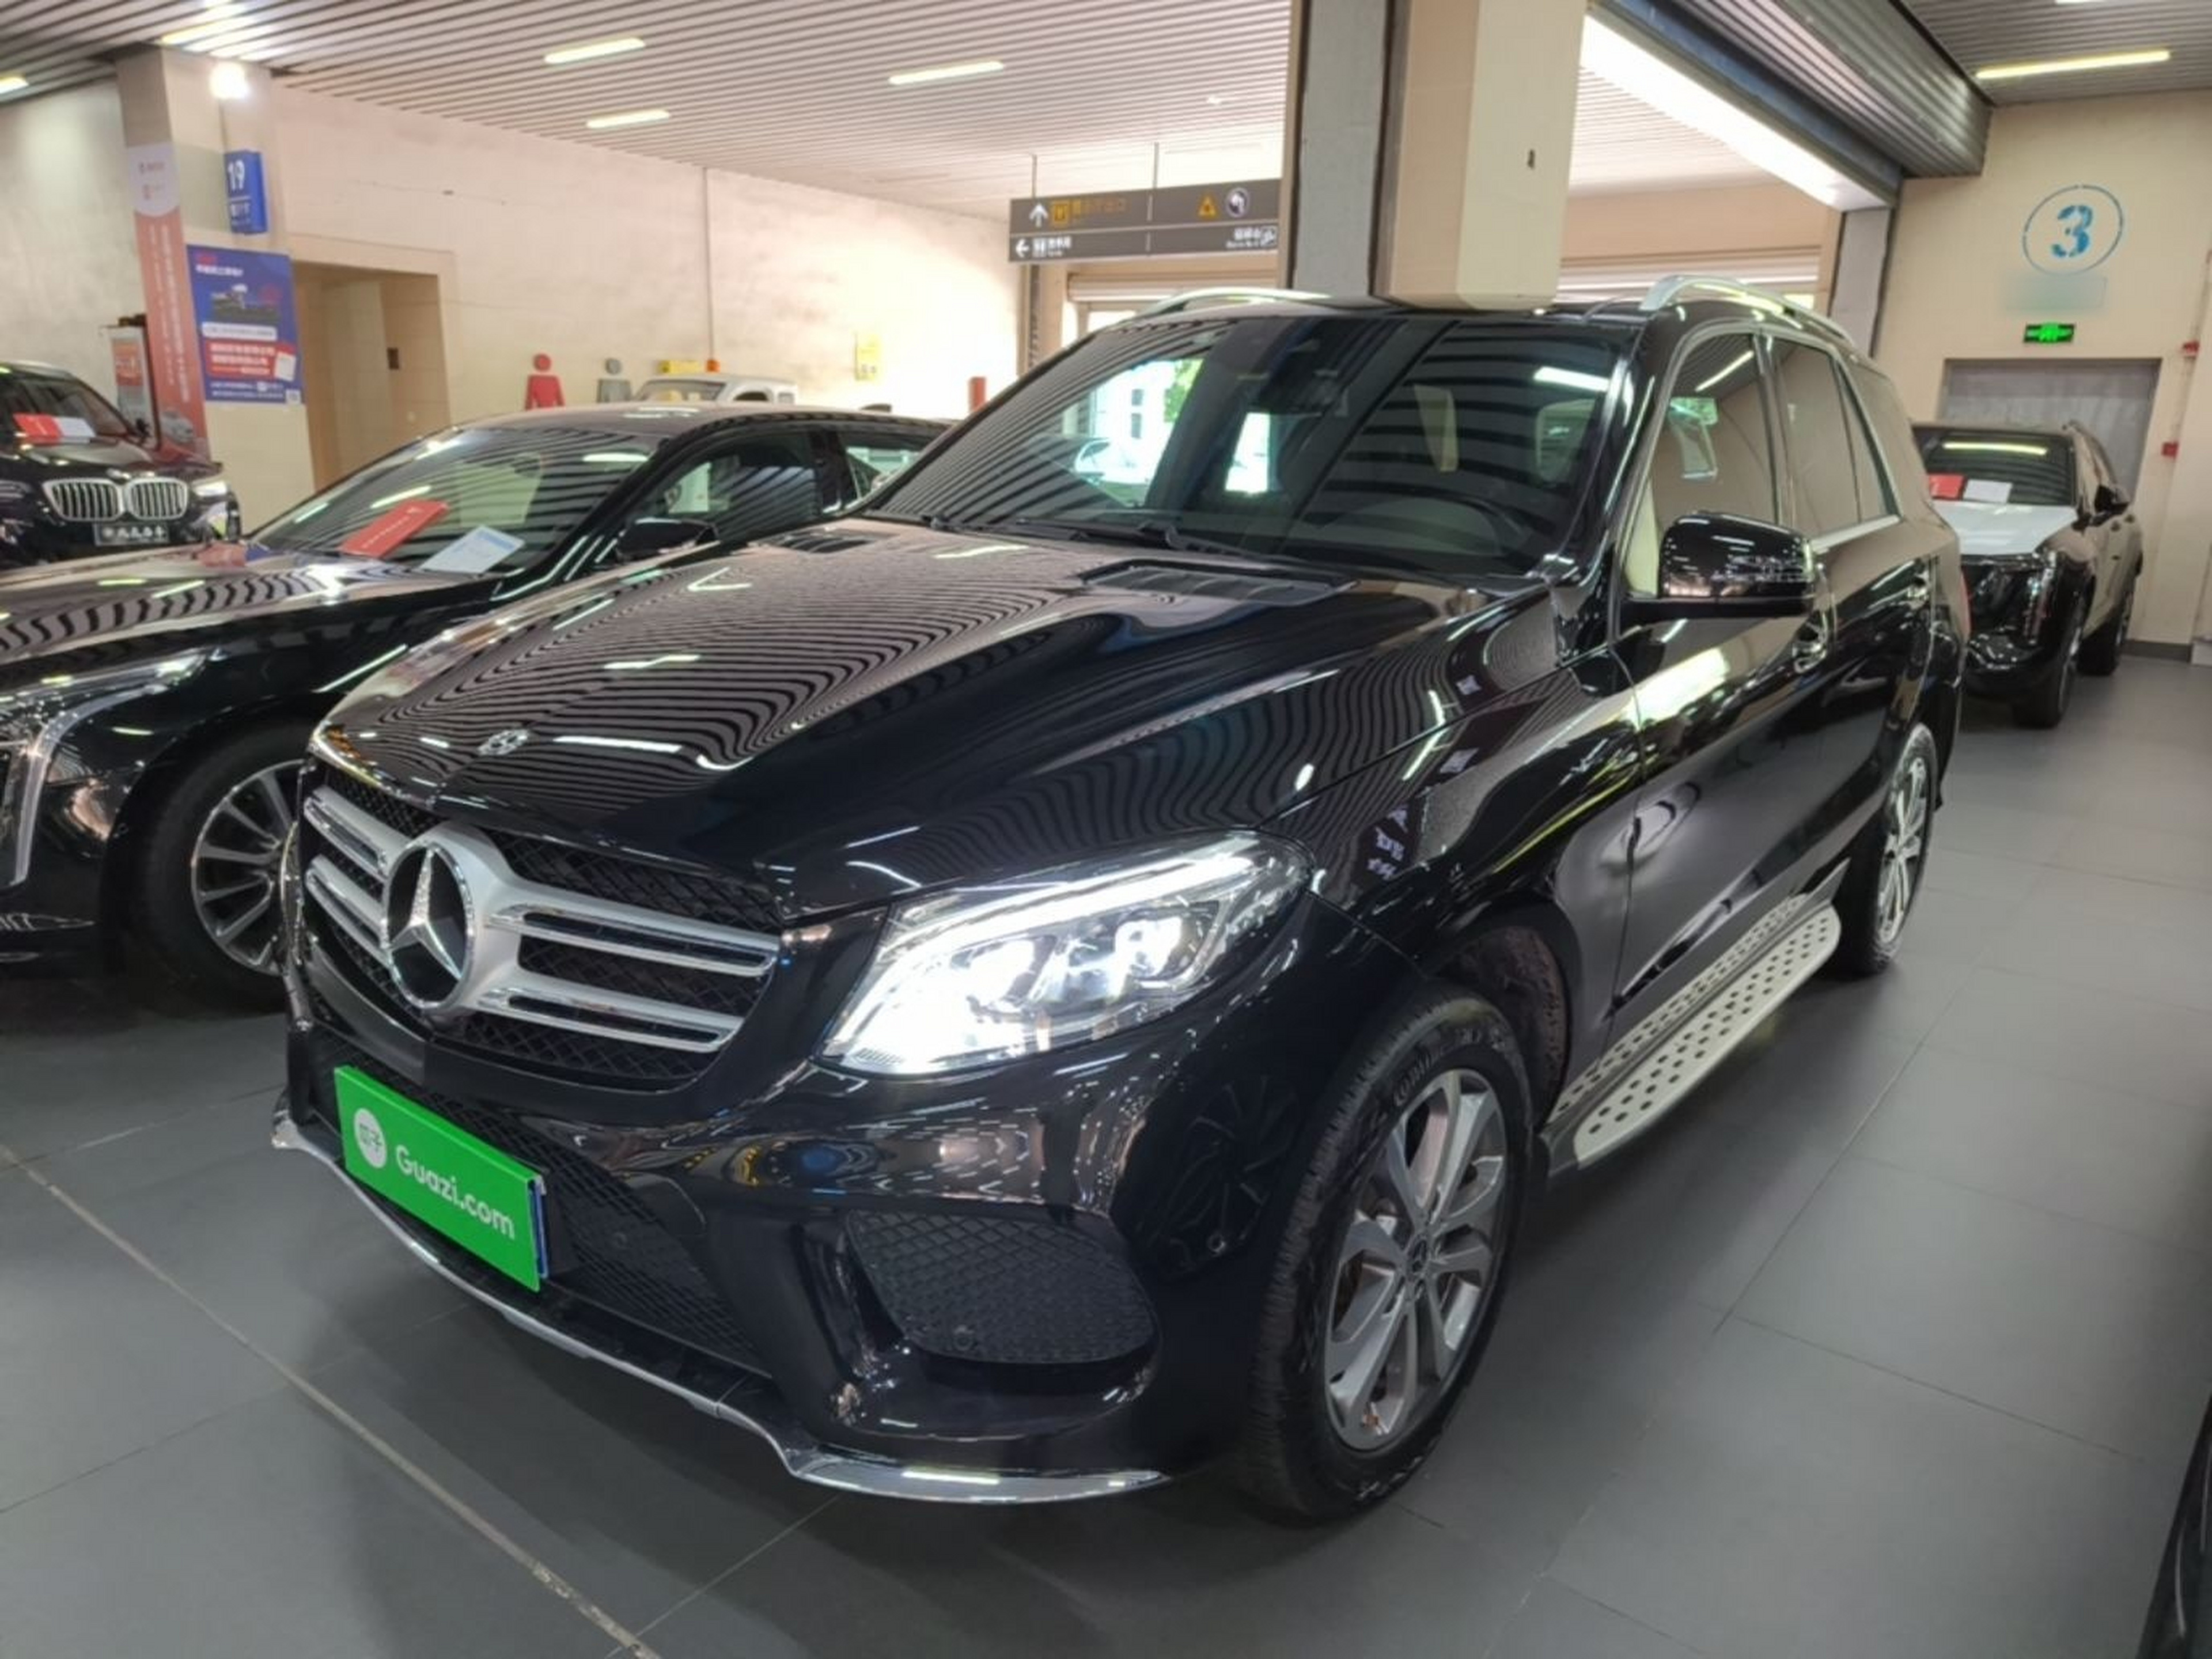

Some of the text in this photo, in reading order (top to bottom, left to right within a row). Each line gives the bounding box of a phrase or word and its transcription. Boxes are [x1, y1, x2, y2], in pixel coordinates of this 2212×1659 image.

[228, 160, 245, 190] 19
[2051, 205, 2092, 257] 3
[396, 1145, 514, 1240] Guazi.com
